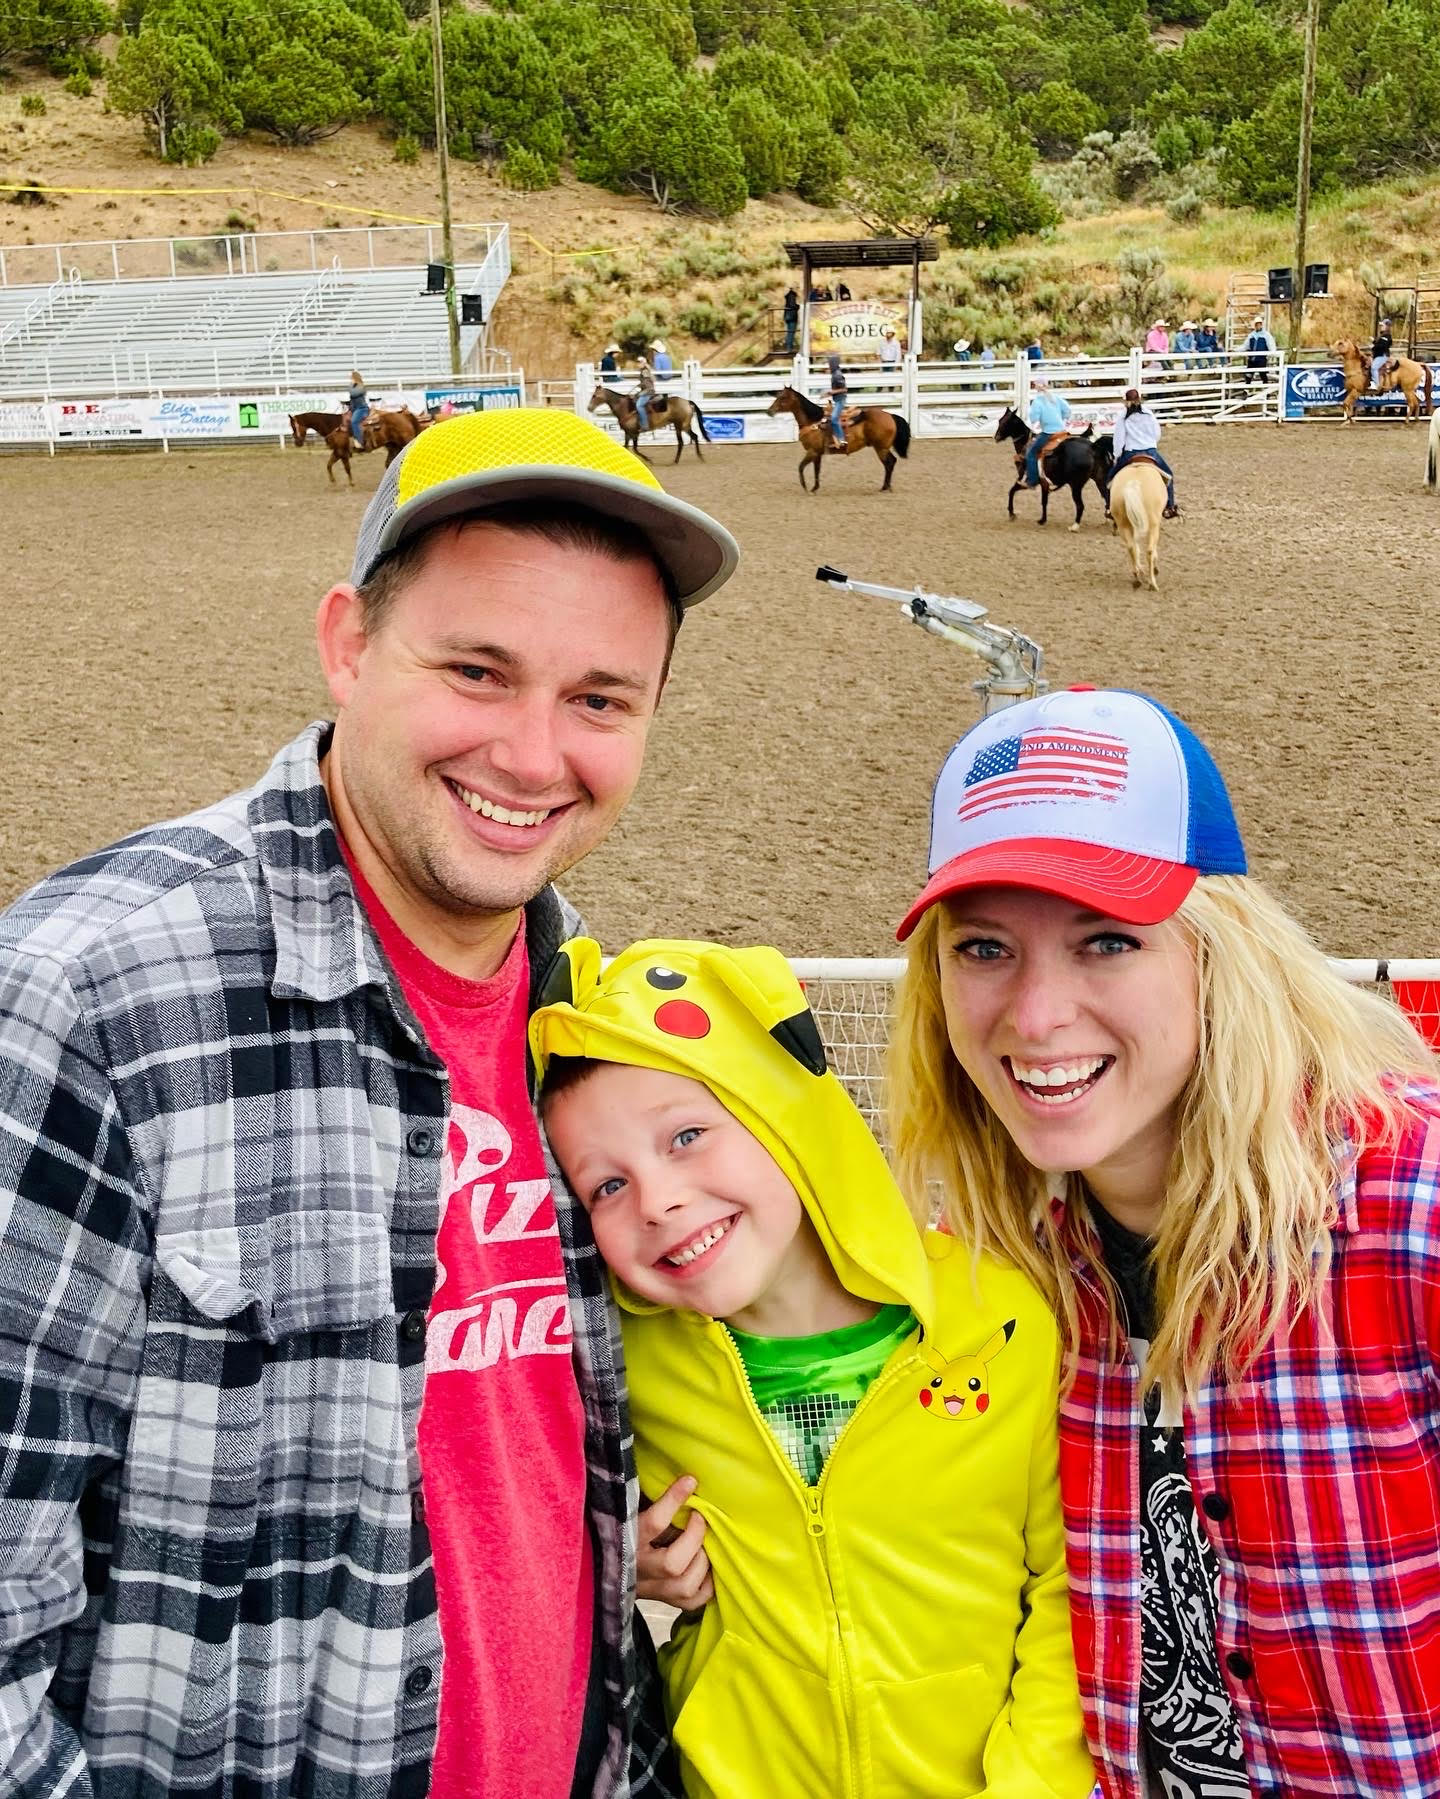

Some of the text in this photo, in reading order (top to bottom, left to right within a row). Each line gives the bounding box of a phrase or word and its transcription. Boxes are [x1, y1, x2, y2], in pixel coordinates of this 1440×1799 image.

[160, 402, 197, 414] Elden
[260, 399, 328, 413] THRESHOLD
[1020, 742, 1128, 759] 2ND AMENDMENT
[437, 1102, 559, 1245] Piz
